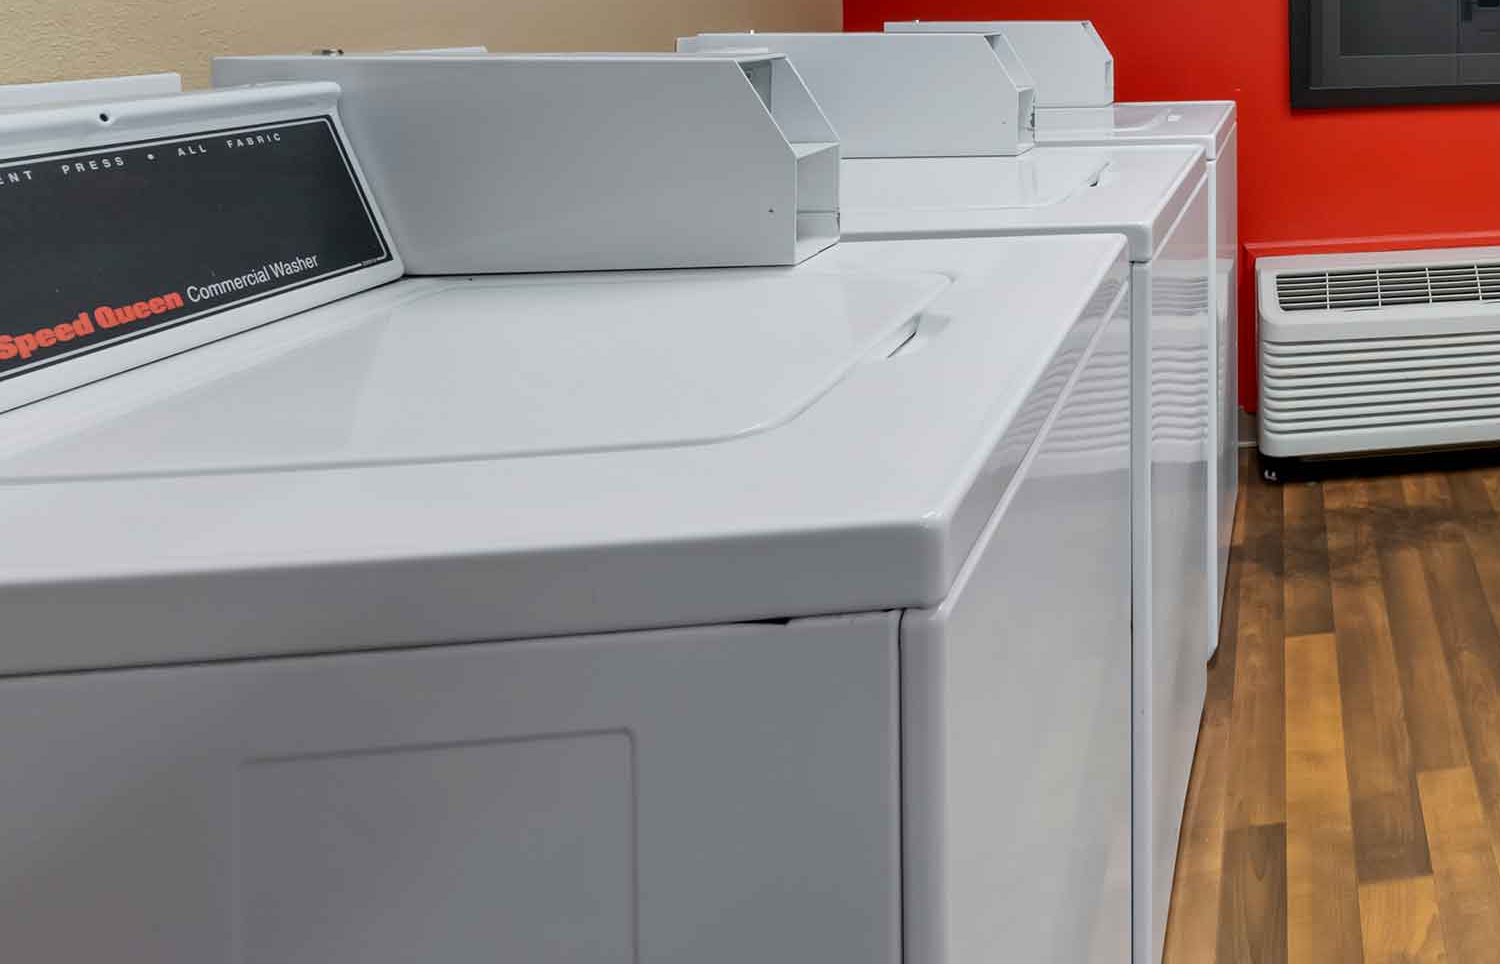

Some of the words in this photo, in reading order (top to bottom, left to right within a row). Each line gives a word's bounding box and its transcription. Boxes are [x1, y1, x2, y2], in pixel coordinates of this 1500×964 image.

[61, 156, 125, 175] PRESS
[177, 144, 207, 157] ALL
[226, 133, 281, 149] FABRIC
[0, 312, 95, 359] Speed
[94, 291, 184, 329] Queen
[186, 263, 271, 303] Commercial
[267, 254, 319, 279] Washer
